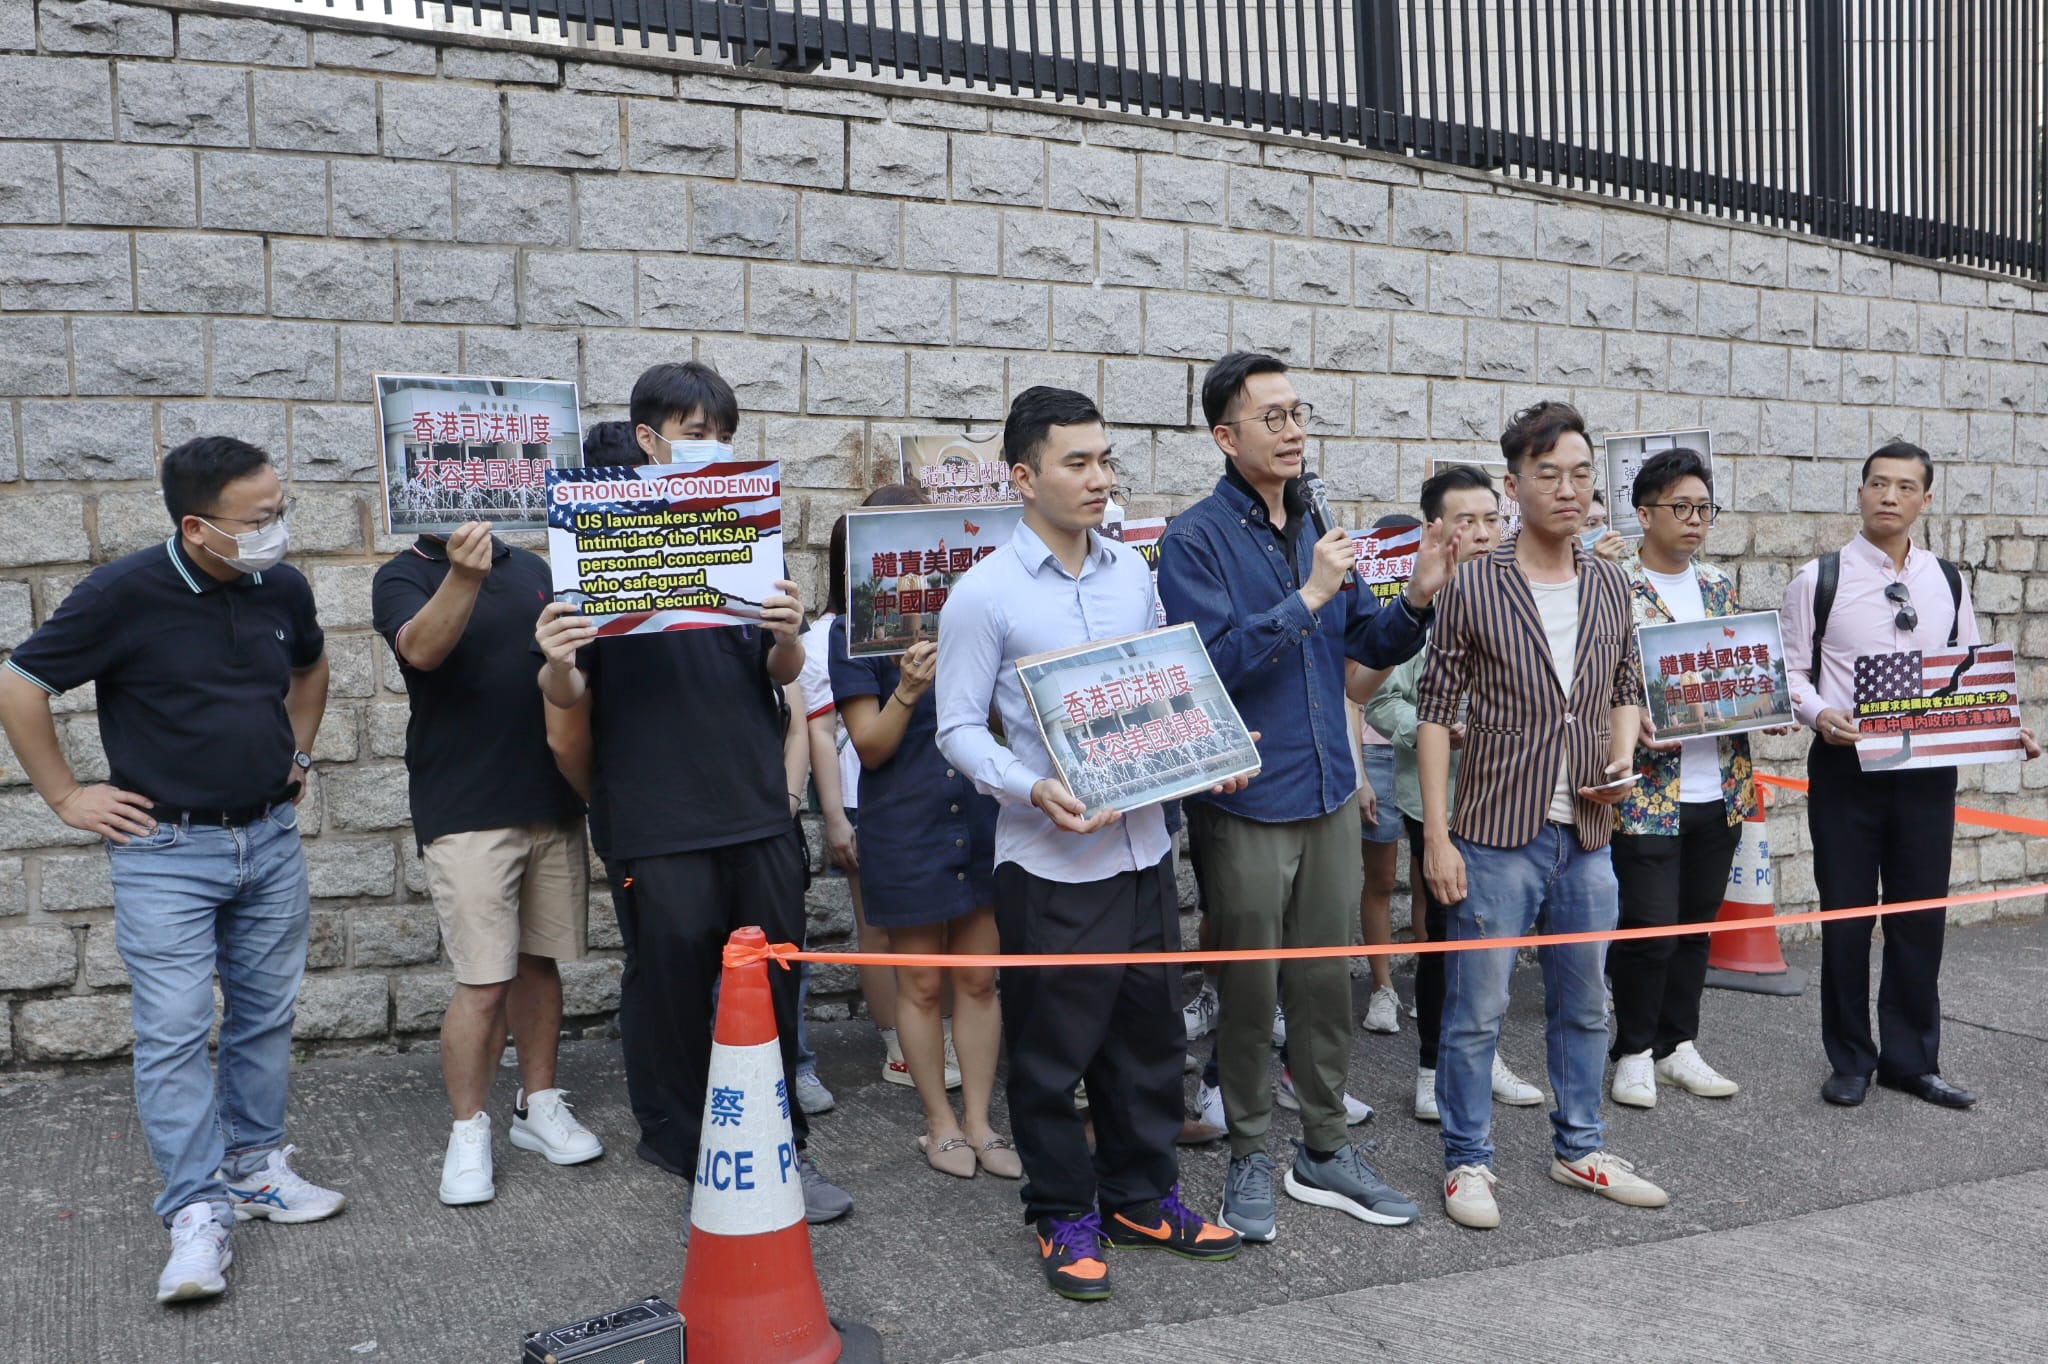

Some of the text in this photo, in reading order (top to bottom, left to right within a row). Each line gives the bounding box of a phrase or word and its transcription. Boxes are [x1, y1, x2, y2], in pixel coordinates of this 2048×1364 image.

[412, 411, 552, 443] 香港司法制度
[415, 458, 552, 490] 不容美國損毀
[556, 477, 771, 502] STRONGLY CONDEMN
[576, 508, 737, 529] US lawmakers who
[578, 527, 757, 551] intimidate the HKSAR
[580, 548, 751, 574] personnel concerned
[1358, 558, 1413, 578] 堅決反對
[582, 571, 705, 593] who safeguard
[1370, 581, 1409, 597] 維護國
[584, 592, 725, 614] national security.
[1659, 643, 1769, 676] 譴責美國侵害
[1063, 663, 1194, 725] 香港司法制度
[1664, 674, 1775, 706] 中國國家安全
[1079, 707, 1215, 768] 不容美國損毀
